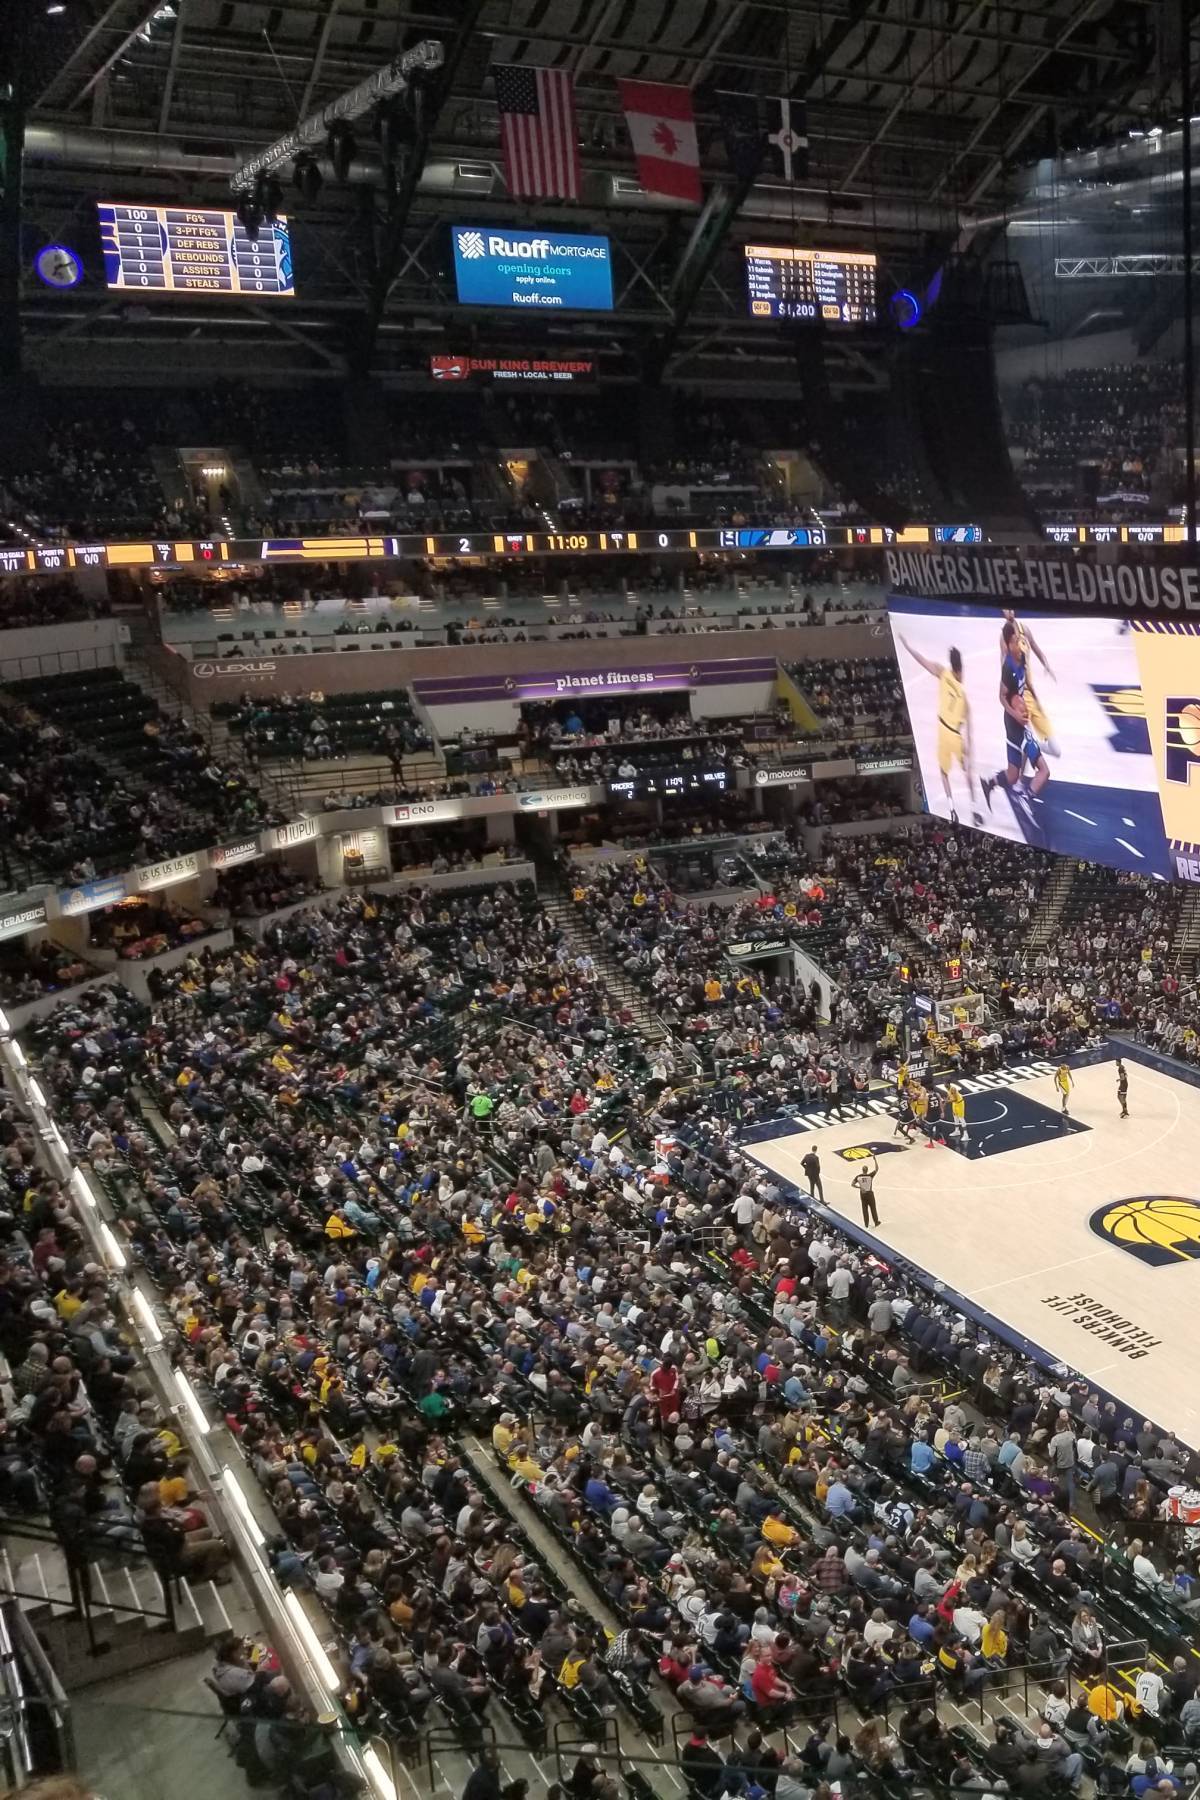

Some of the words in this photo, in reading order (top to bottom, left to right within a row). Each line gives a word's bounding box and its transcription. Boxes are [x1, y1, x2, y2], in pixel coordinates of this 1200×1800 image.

[127, 209, 147, 220] 100
[186, 214, 205, 223] FG%
[135, 224, 142, 232] 0
[176, 227, 198, 235] 3-PT
[199, 227, 218, 237] FG%
[136, 237, 143, 246] 1
[177, 239, 195, 249] DEF
[197, 240, 220, 249] REBS
[252, 243, 259, 252] 0
[488, 236, 550, 259] Ruoff
[550, 244, 606, 259] MORTGAGE
[138, 250, 145, 259] 1
[175, 252, 224, 263] REBOUNDS
[253, 256, 260, 265] 0
[139, 263, 147, 272] 0
[183, 265, 220, 275] ASSISTS
[498, 264, 540, 275] opening
[543, 263, 571, 275] doors
[254, 269, 261, 278] 0
[141, 276, 149, 285] 0
[186, 279, 220, 288] STEALS
[516, 276, 534, 284] apply
[256, 282, 263, 290] 0
[513, 293, 562, 304] Ruoff.com
[471, 359, 497, 370] SUN
[500, 360, 530, 371] KING
[533, 361, 592, 372] BREWERY
[459, 539, 470, 552] 2
[548, 535, 588, 550] 11:09
[658, 534, 668, 548] 0
[85, 554, 99, 564] 0/0
[160, 551, 168, 560] 7
[203, 550, 212, 560] 0
[3, 559, 18, 571] 1/1
[45, 557, 60, 567] 0/0
[887, 551, 972, 594] BANKERS
[974, 555, 1021, 598] LIFE
[214, 662, 276, 673] LEXUS
[556, 673, 604, 690] planet
[606, 671, 654, 685] fitness
[769, 768, 807, 780] motorola
[412, 805, 435, 815] CNO
[289, 820, 315, 841] IUPUI
[225, 841, 256, 857] DATABANK
[4, 907, 45, 927] GRAPHICS
[1040, 1295, 1080, 1316] LIFE
[1066, 1293, 1163, 1348] FIELDHOUSE
[1072, 1315, 1150, 1360] BANKERS
[1143, 1687, 1148, 1700] 7
